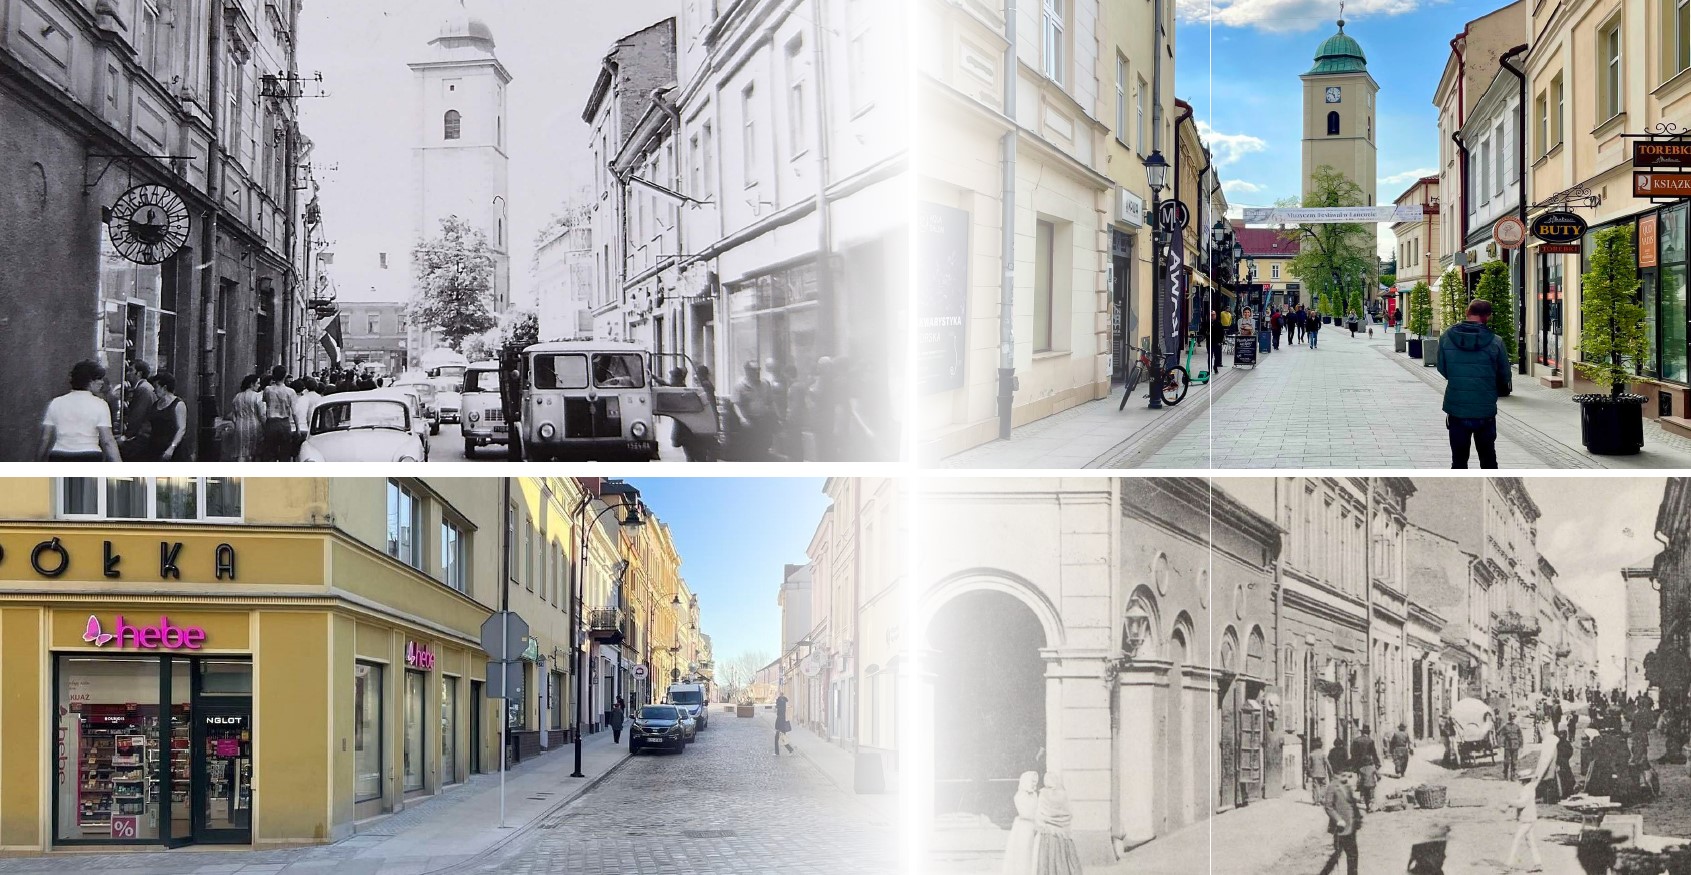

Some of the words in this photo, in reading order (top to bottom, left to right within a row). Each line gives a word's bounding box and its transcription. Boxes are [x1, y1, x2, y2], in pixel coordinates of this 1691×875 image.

[1540, 225, 1581, 235] BUTY
[918, 316, 962, 329] KWARYSTYKA
[0, 537, 235, 580] ÓŁKA
[115, 614, 206, 650] hebe
[415, 641, 435, 670] hebe
[70, 693, 91, 701] KIJAŻ
[59, 726, 69, 785] hebe
